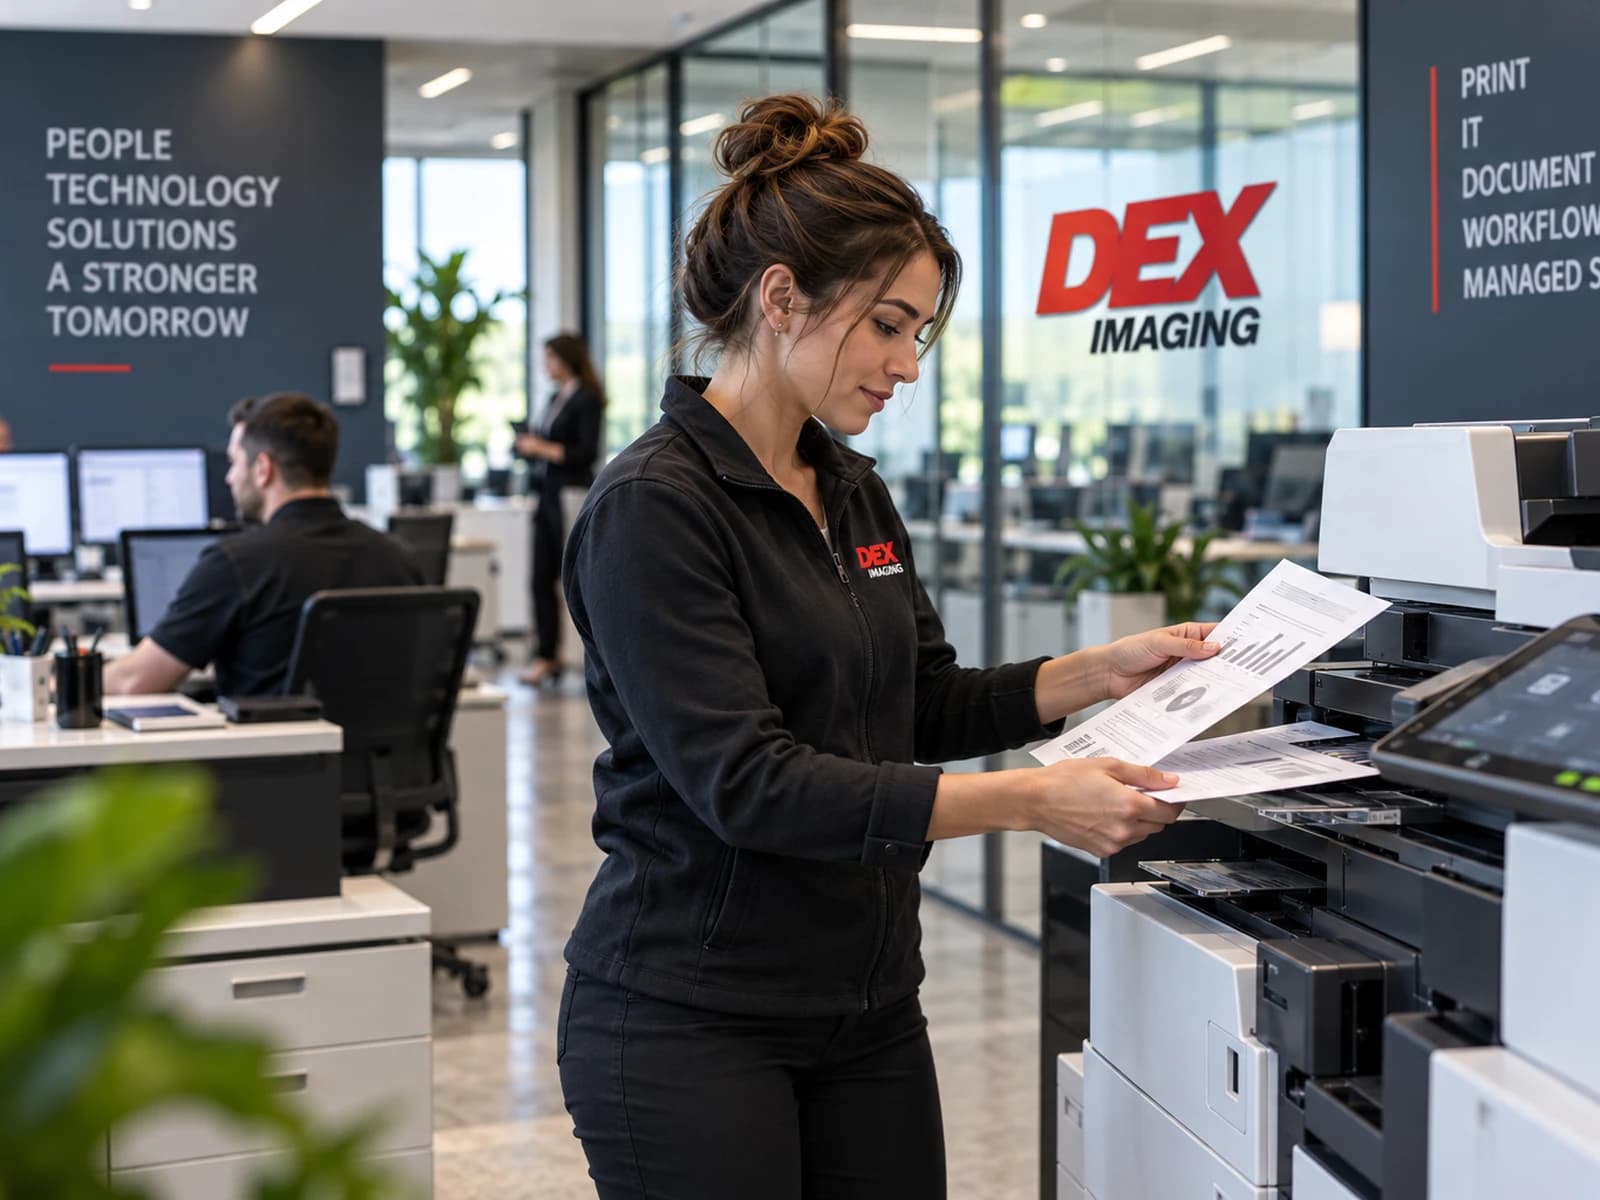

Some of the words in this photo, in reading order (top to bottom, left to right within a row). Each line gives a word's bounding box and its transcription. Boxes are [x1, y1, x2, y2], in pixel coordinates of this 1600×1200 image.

[1461, 57, 1531, 99] PRINT
[46, 127, 173, 161] PEOPLE
[1461, 115, 1483, 150] IT
[46, 173, 280, 208] TECHNOLOGY
[1462, 151, 1596, 200] DOCUMENT
[47, 217, 237, 251] SOLUTIONS
[1462, 203, 1600, 249] WORKFLOW
[1036, 181, 1278, 317] DEX
[46, 262, 71, 293] A
[82, 262, 258, 294] STRONGER
[1463, 258, 1582, 300] MANAGED
[46, 305, 249, 338] TOMORROW
[1090, 306, 1261, 354] IMAGING
[855, 541, 900, 569] DEX
